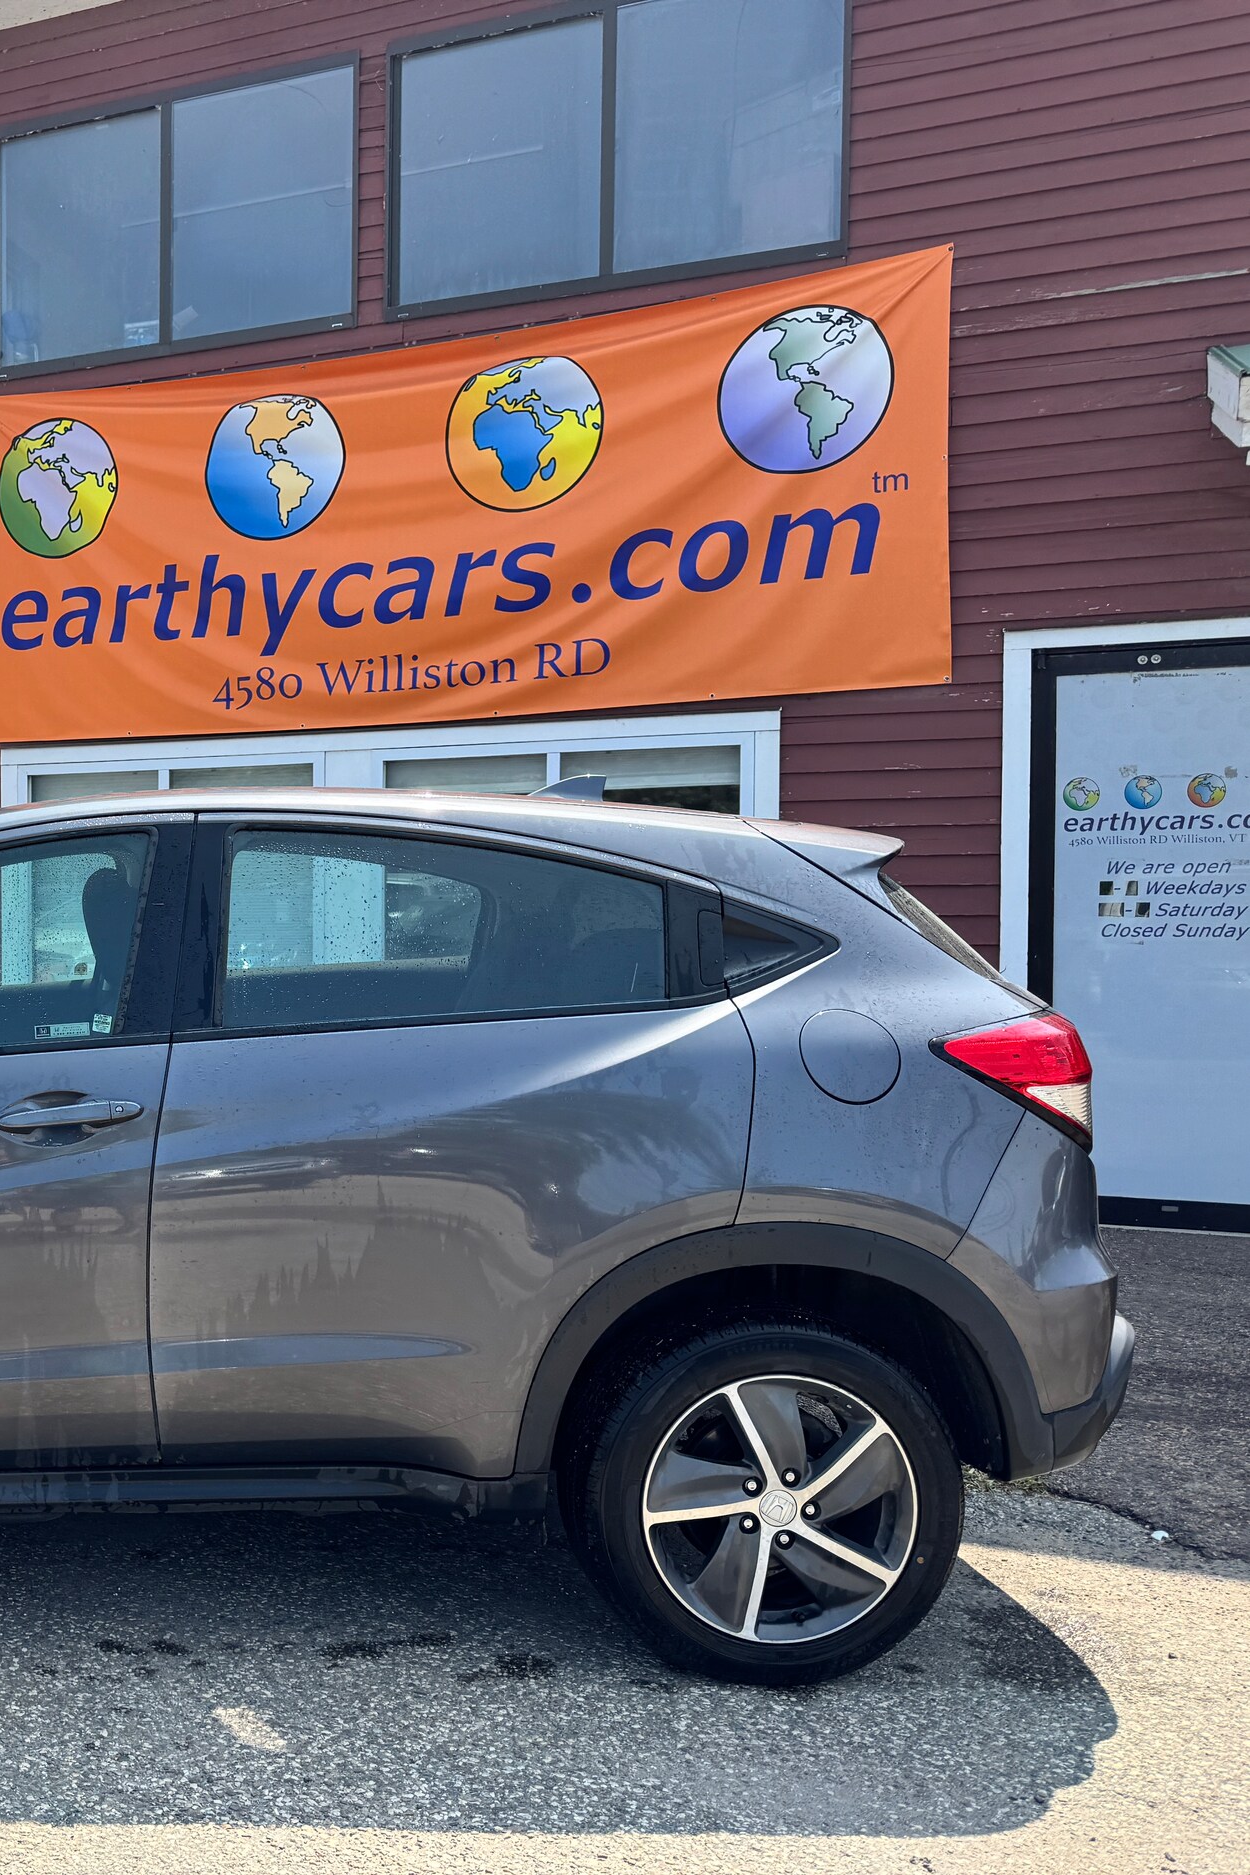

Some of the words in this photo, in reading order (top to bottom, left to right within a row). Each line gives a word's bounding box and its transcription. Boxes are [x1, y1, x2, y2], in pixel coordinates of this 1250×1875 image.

[871, 470, 910, 494] tm
[0, 502, 881, 657] earthycars.com
[212, 666, 303, 711] 4580
[316, 653, 517, 697] Williston
[533, 637, 611, 680] RD
[1068, 836, 1094, 848] 4580
[1096, 834, 1146, 846] Williston
[1150, 834, 1168, 846] RD
[1170, 833, 1226, 845] Williston,
[1229, 833, 1248, 843] VT
[1106, 860, 1136, 875] We
[1142, 862, 1175, 874] are
[1182, 861, 1232, 877] open
[1146, 880, 1247, 898] Weekdays
[1155, 902, 1249, 920] Saturday
[1101, 922, 1168, 938] Closed
[1172, 922, 1250, 941] Sunday
